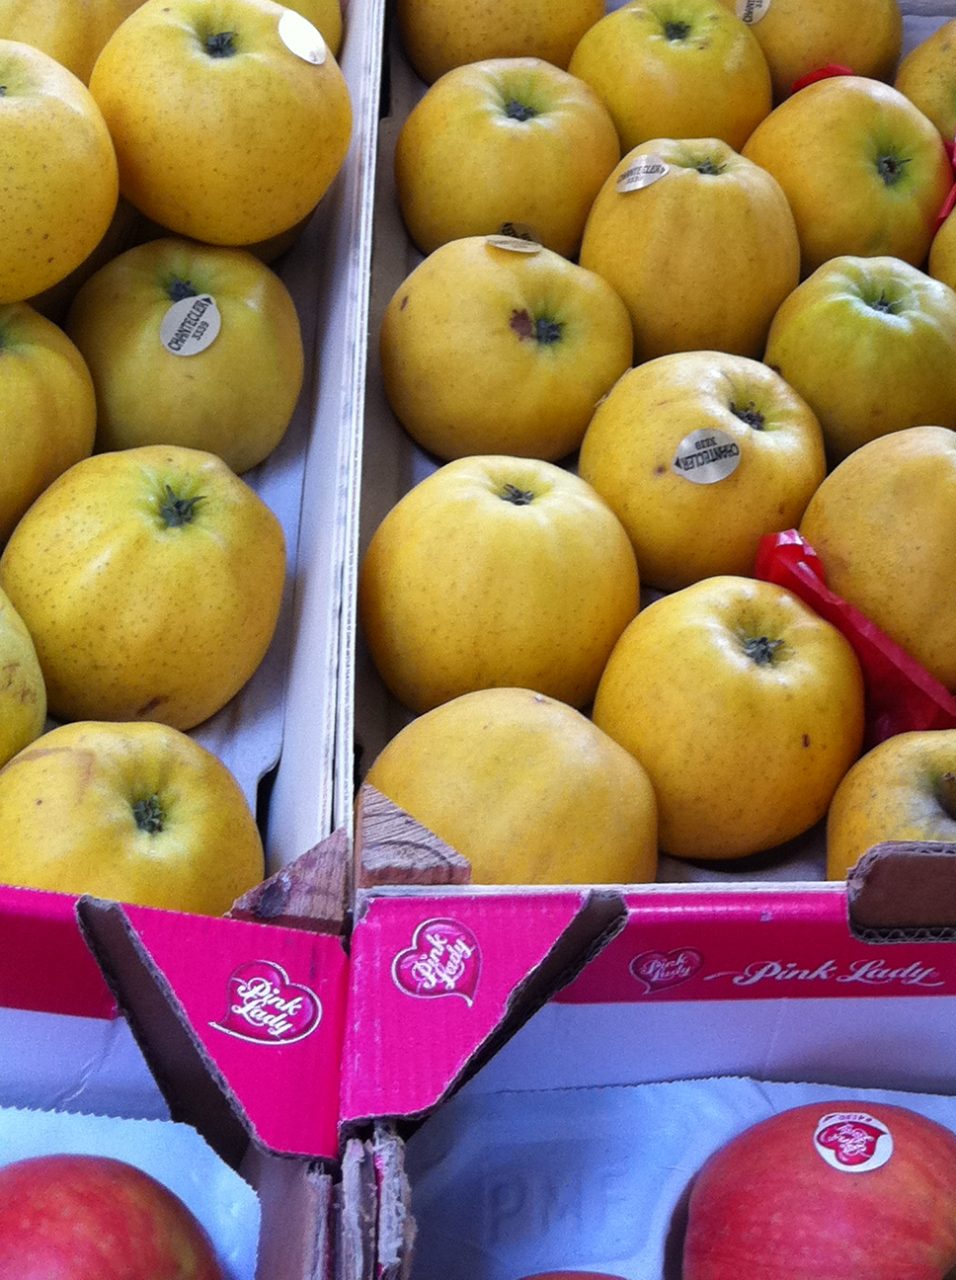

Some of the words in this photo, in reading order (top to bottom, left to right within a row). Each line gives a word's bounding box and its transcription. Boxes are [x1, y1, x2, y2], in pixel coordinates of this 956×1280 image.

[167, 297, 209, 353] CHANTECLER
[678, 442, 739, 471] CHANTECLER
[412, 931, 448, 989] Pink
[434, 936, 474, 990] Lady
[641, 952, 688, 975] Pink
[651, 964, 693, 981] Lady
[724, 959, 838, 985] Pink
[835, 959, 945, 987] Lady
[235, 976, 304, 1016] Pink
[231, 999, 294, 1036] Lady
